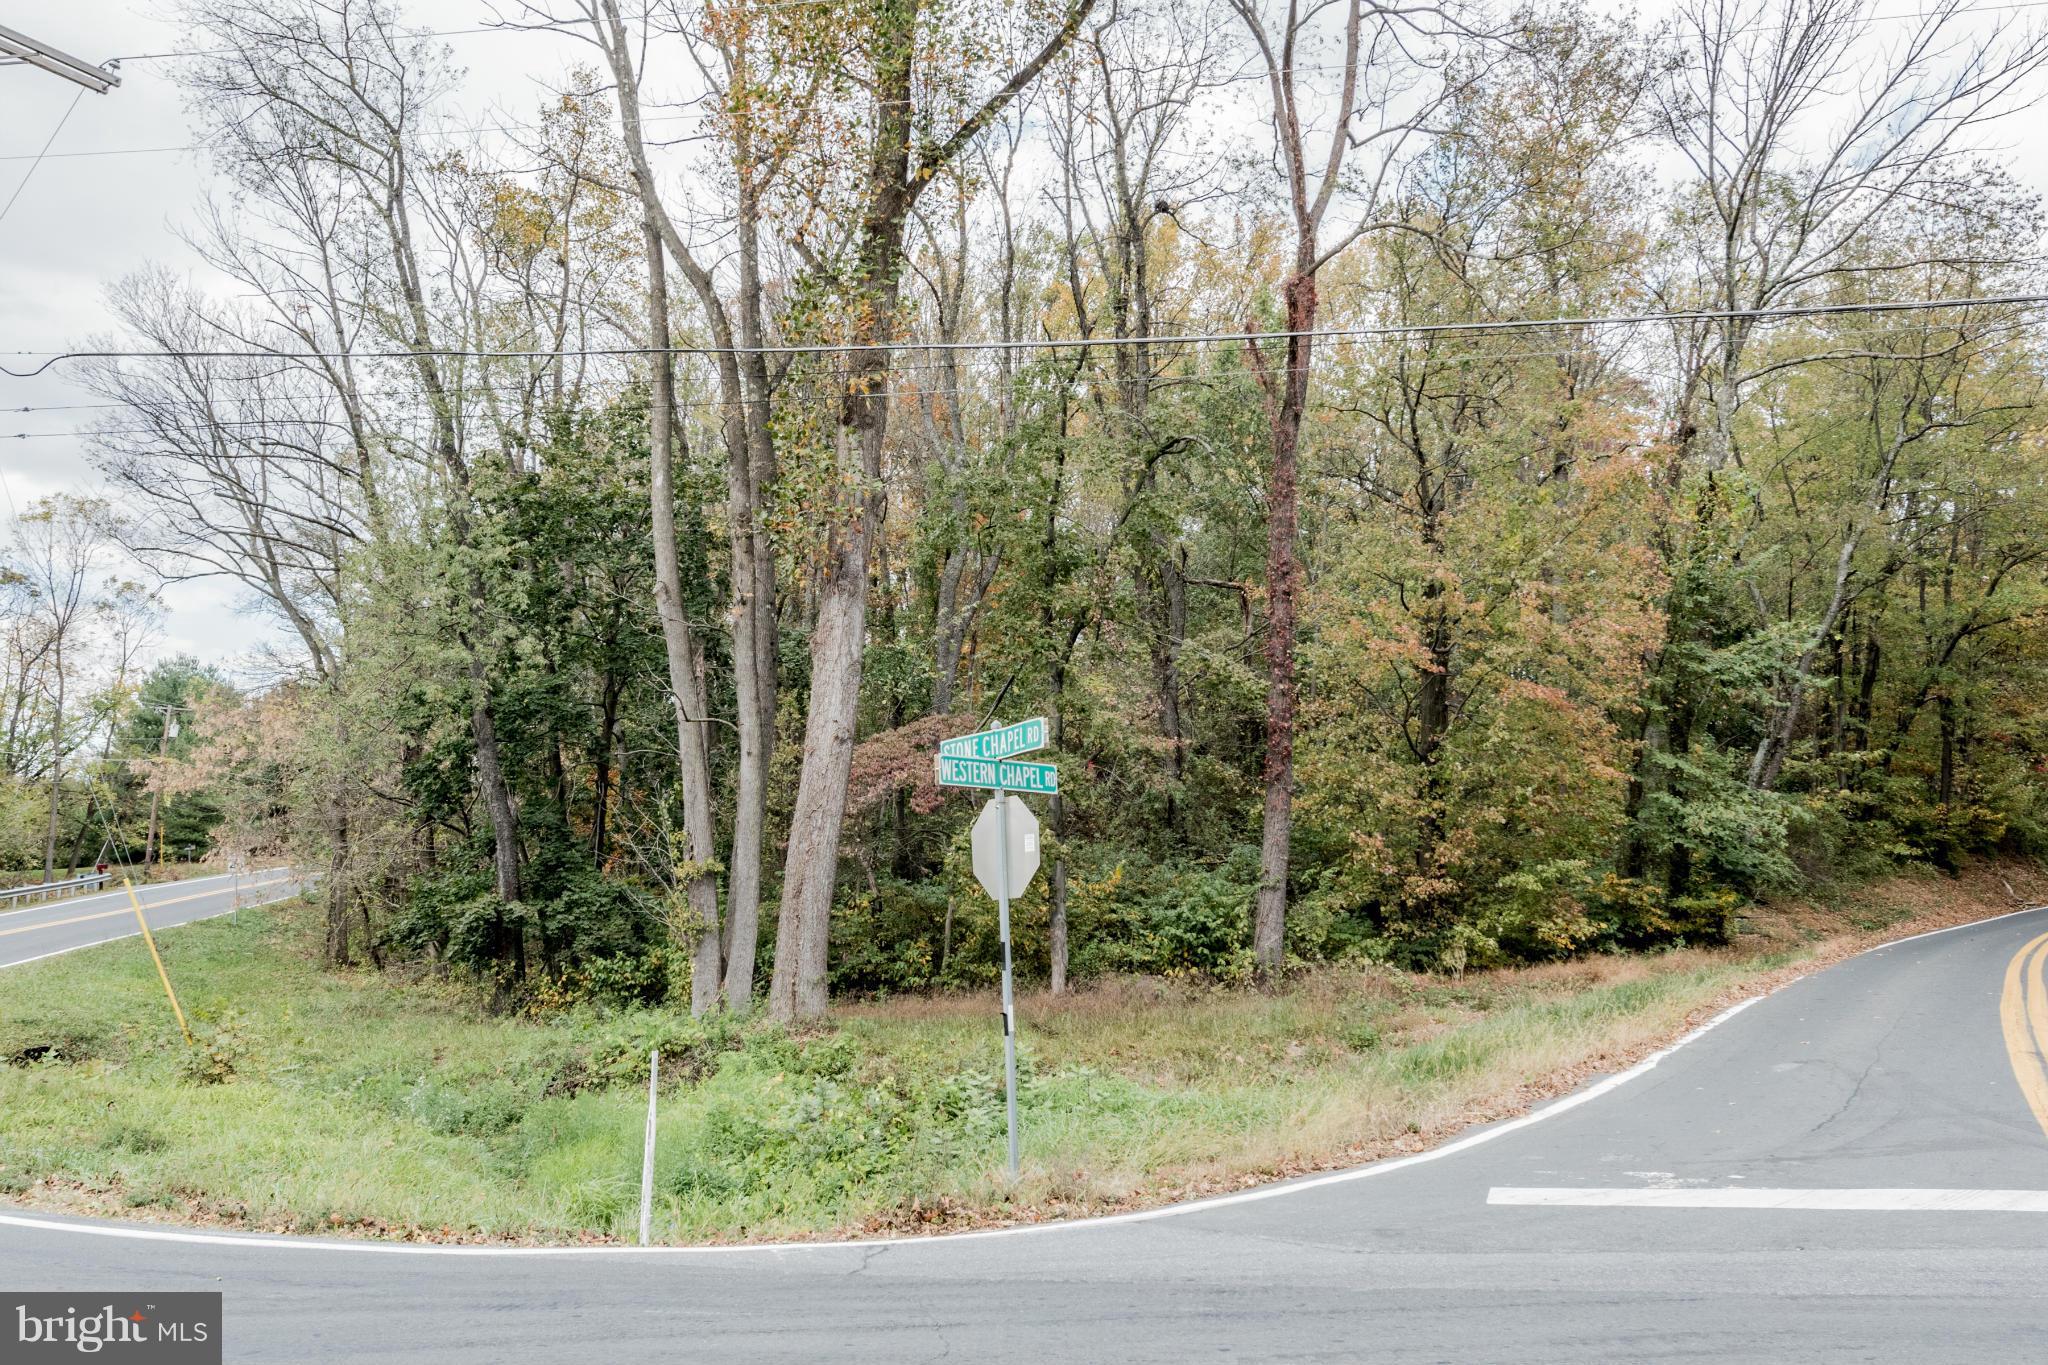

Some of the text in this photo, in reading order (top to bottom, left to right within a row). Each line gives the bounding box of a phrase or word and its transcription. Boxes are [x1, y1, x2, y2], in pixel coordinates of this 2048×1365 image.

[943, 725, 1039, 757] STONE CHAPEL RD
[941, 758, 1056, 788] WESTERN CHAPEL RD
